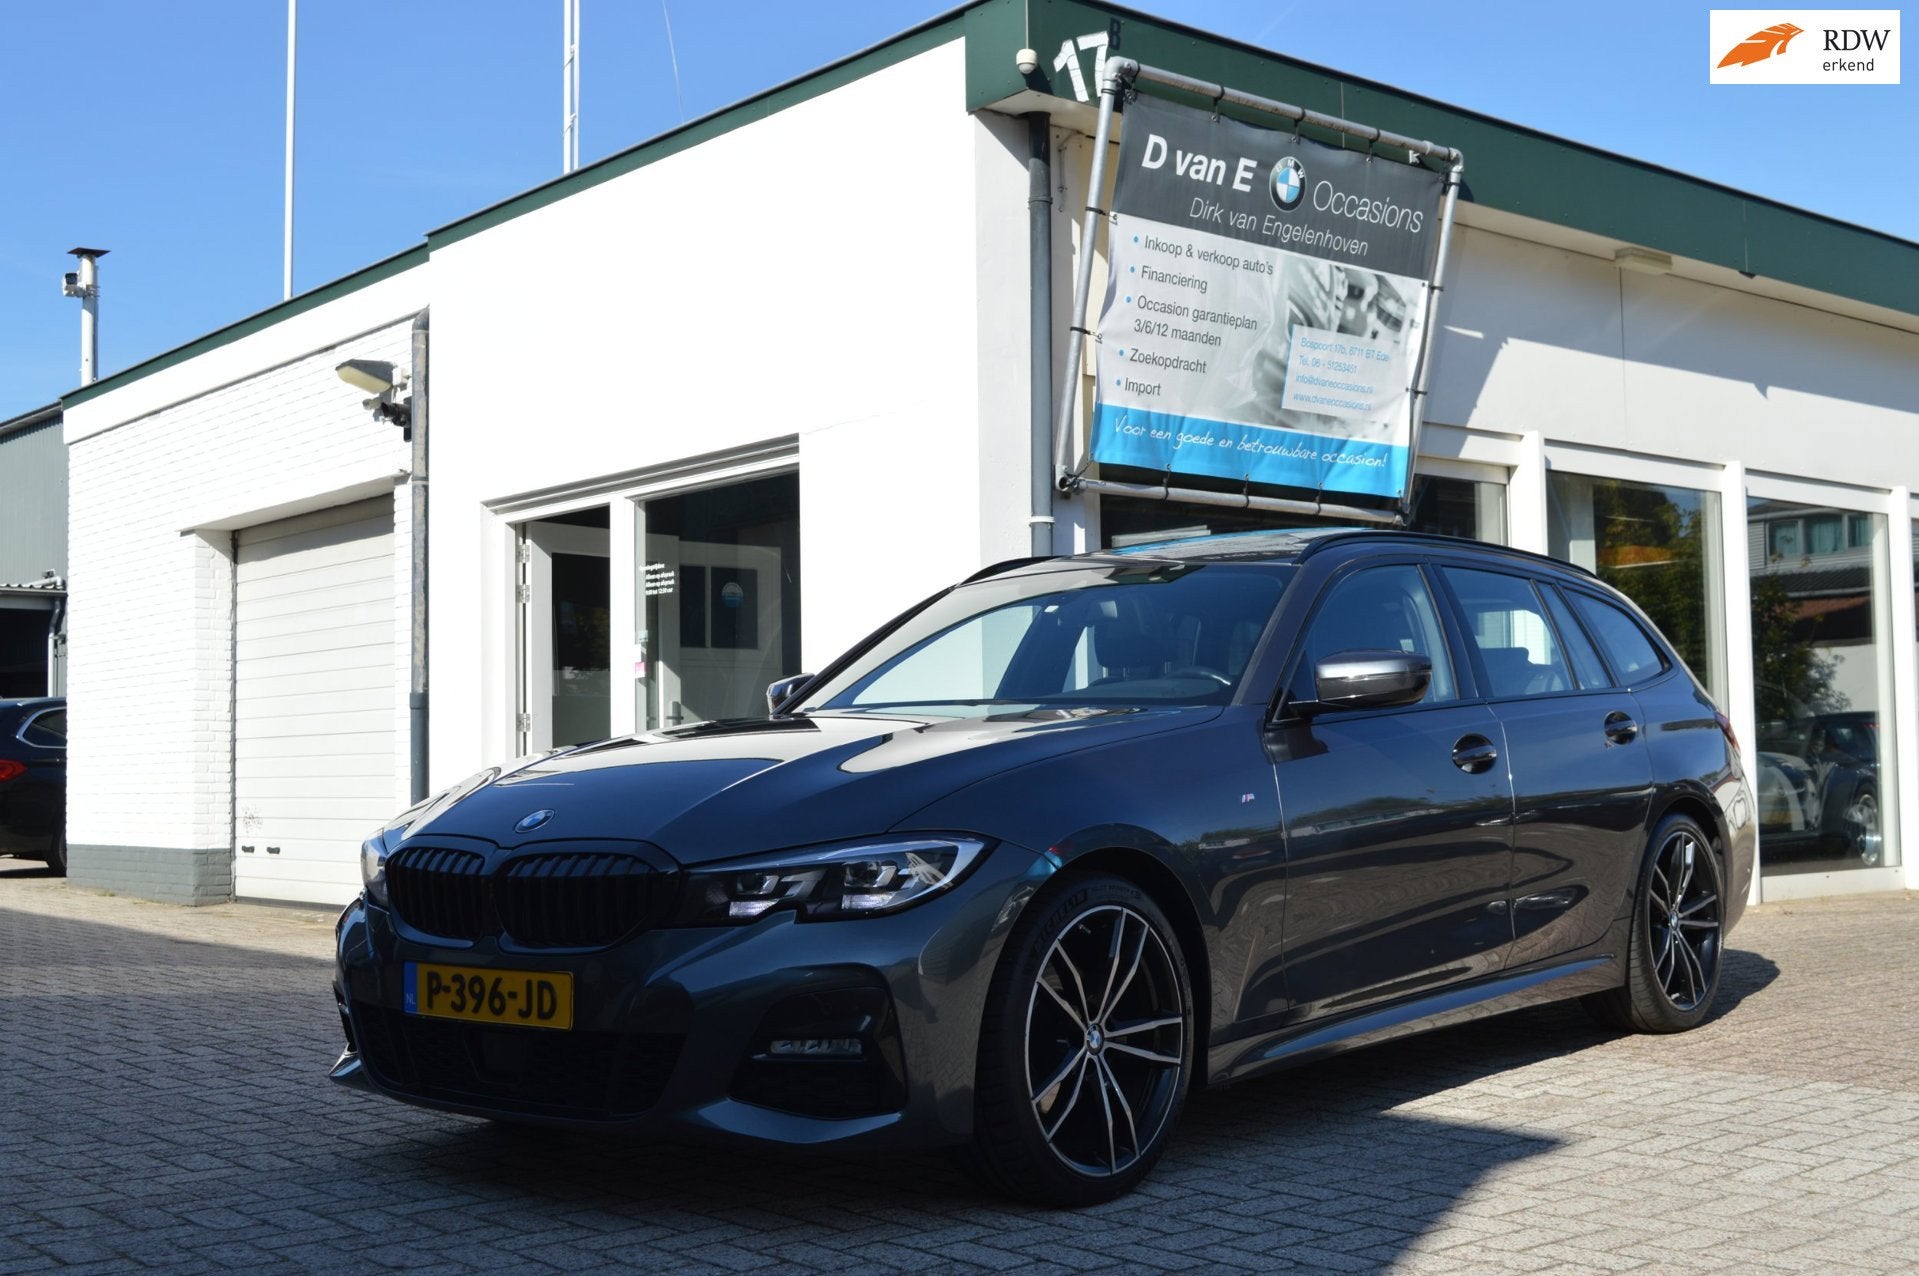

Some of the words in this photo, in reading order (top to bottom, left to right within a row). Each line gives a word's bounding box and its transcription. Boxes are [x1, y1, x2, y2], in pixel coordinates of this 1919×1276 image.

[1053, 30, 1109, 102] 17
[1141, 133, 1168, 169] D
[1176, 149, 1227, 186] van
[1232, 157, 1258, 193] E
[1313, 180, 1424, 233] Occasions
[1189, 196, 1225, 224] Dirk
[1229, 210, 1257, 231] van
[1262, 214, 1369, 257] Engelenhoven
[1144, 235, 1183, 259] Inkoop
[1186, 243, 1194, 258] &
[1197, 248, 1240, 271] verkoop
[1242, 257, 1274, 276] auto's
[1141, 265, 1208, 294] Financiering
[1137, 295, 1189, 317] Occasion
[1191, 308, 1258, 331] garantieplan
[1134, 318, 1169, 338] 3/6/12
[1171, 327, 1222, 347] maanden
[1129, 348, 1207, 374] Zoekopdracht
[1124, 377, 1161, 397] Import
[1115, 415, 1146, 435] Voor
[1149, 429, 1172, 440] een
[1173, 431, 1215, 450] goede
[1218, 438, 1233, 448] en
[1236, 434, 1317, 460] betrouwbare
[1321, 452, 1388, 467] occasion!
[406, 992, 417, 1005] NL
[426, 970, 558, 1021] P-396-JD
